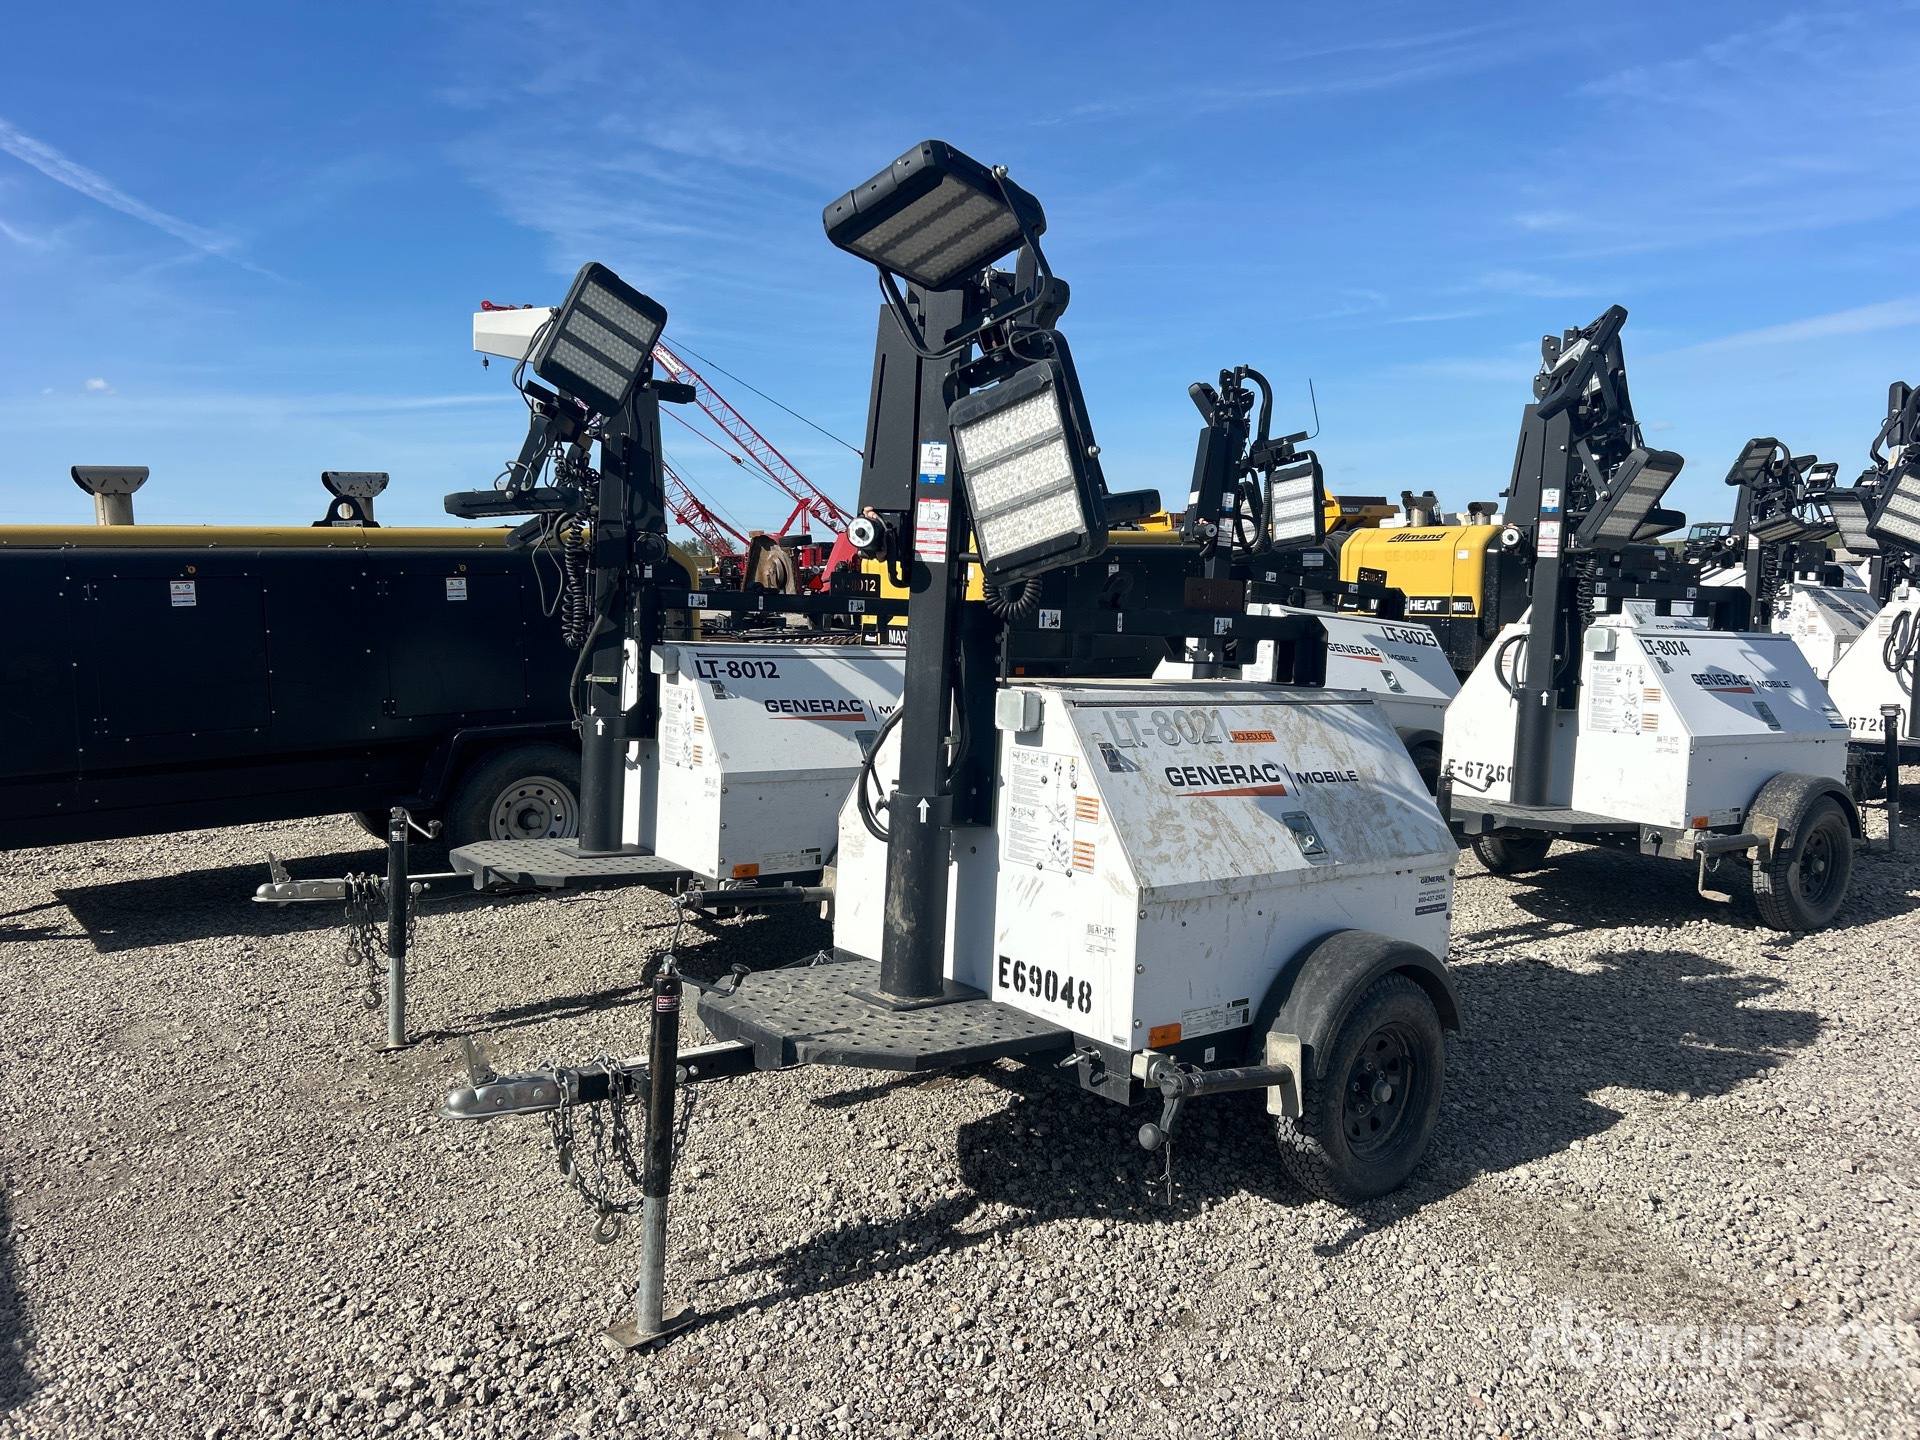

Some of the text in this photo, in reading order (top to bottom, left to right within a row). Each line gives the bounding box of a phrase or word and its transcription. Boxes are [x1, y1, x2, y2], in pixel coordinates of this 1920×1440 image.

[1387, 532, 1448, 542] Allmand
[1409, 600, 1441, 611] HEAT
[888, 630, 908, 645] MAX
[1380, 626, 1438, 647] LT-8025
[1328, 643, 1418, 662] GENERAC MOBILE
[1639, 640, 1691, 656] LT-8014
[695, 660, 780, 679] LT-8012
[1691, 674, 1791, 688] GENERAC MOBILE
[764, 699, 864, 713] GENERAC
[1102, 709, 1275, 748] LT-8021 AQUEDUCTS
[1165, 764, 1359, 787] GENERAC MOBILE
[998, 955, 1092, 1014] E69048
